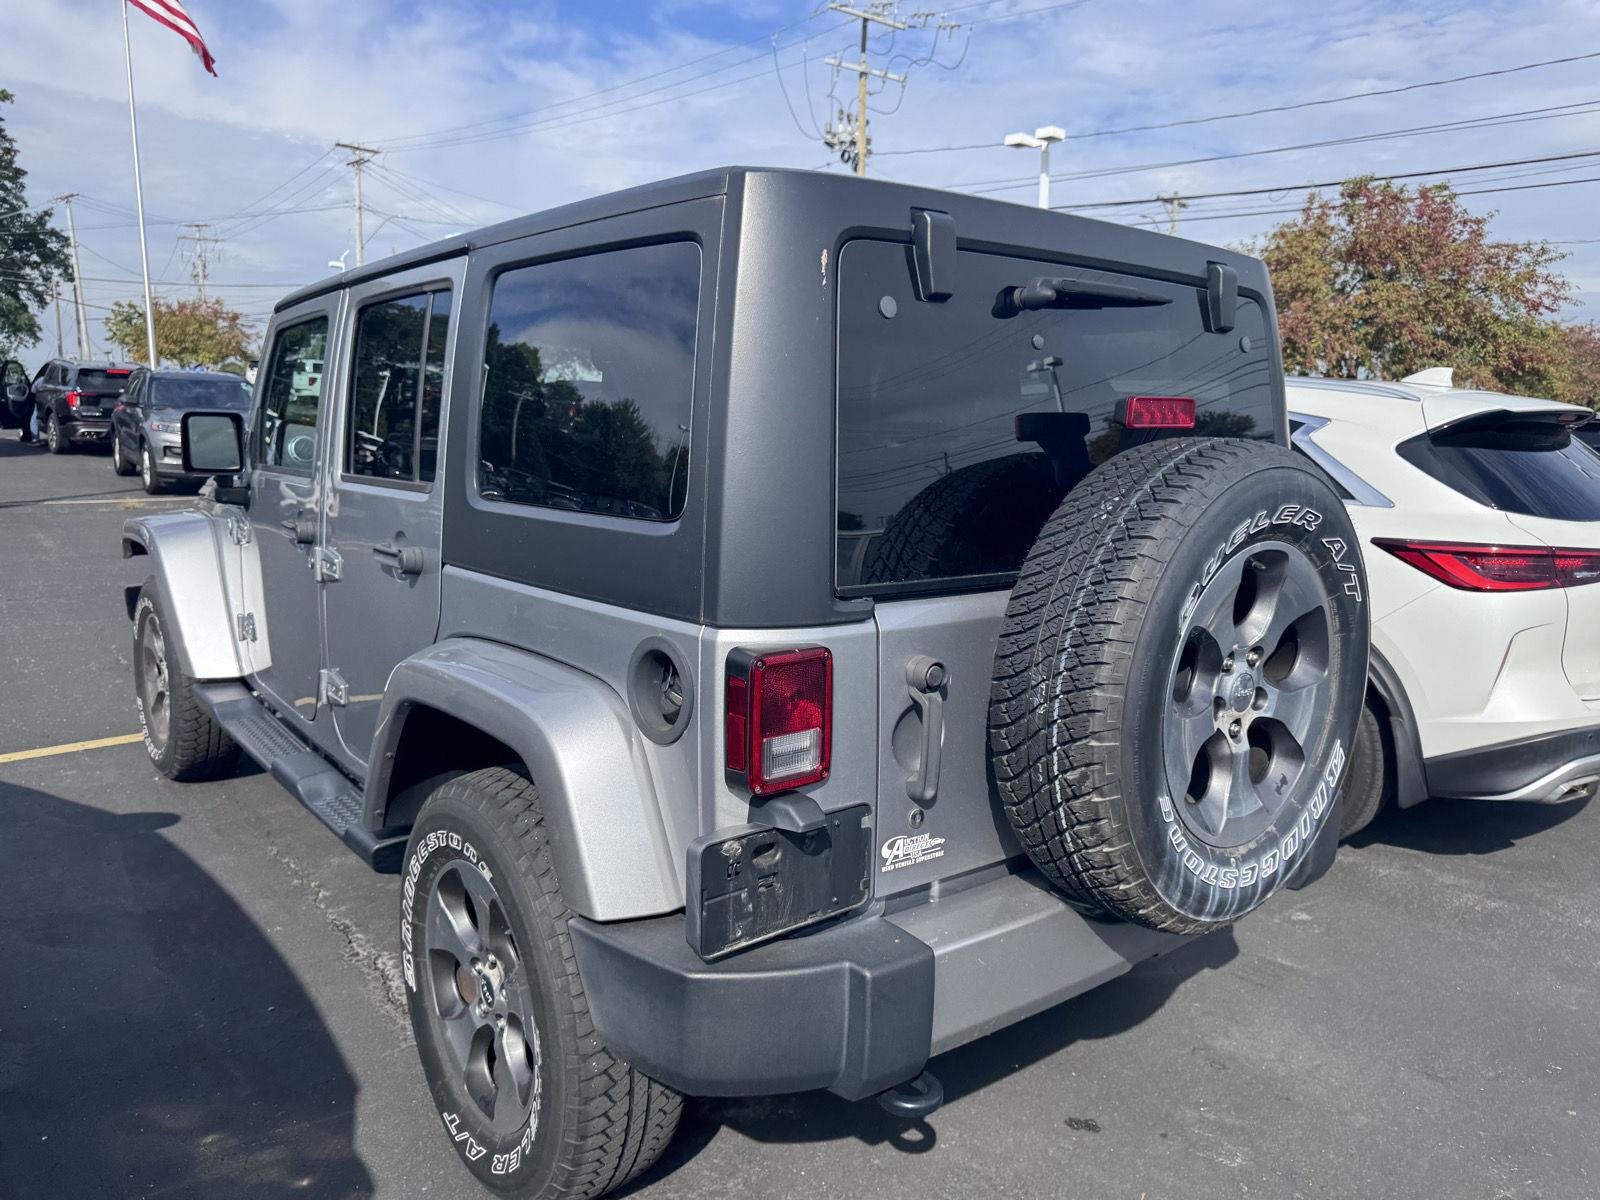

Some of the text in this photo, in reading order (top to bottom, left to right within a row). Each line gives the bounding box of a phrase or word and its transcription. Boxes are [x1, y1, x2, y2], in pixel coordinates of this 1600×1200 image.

[1321, 537, 1362, 602] A/T
[1159, 738, 1346, 889] BRIDGESTONE
[402, 830, 494, 993] BRIDGESTONE
[443, 1112, 487, 1161] A/T
